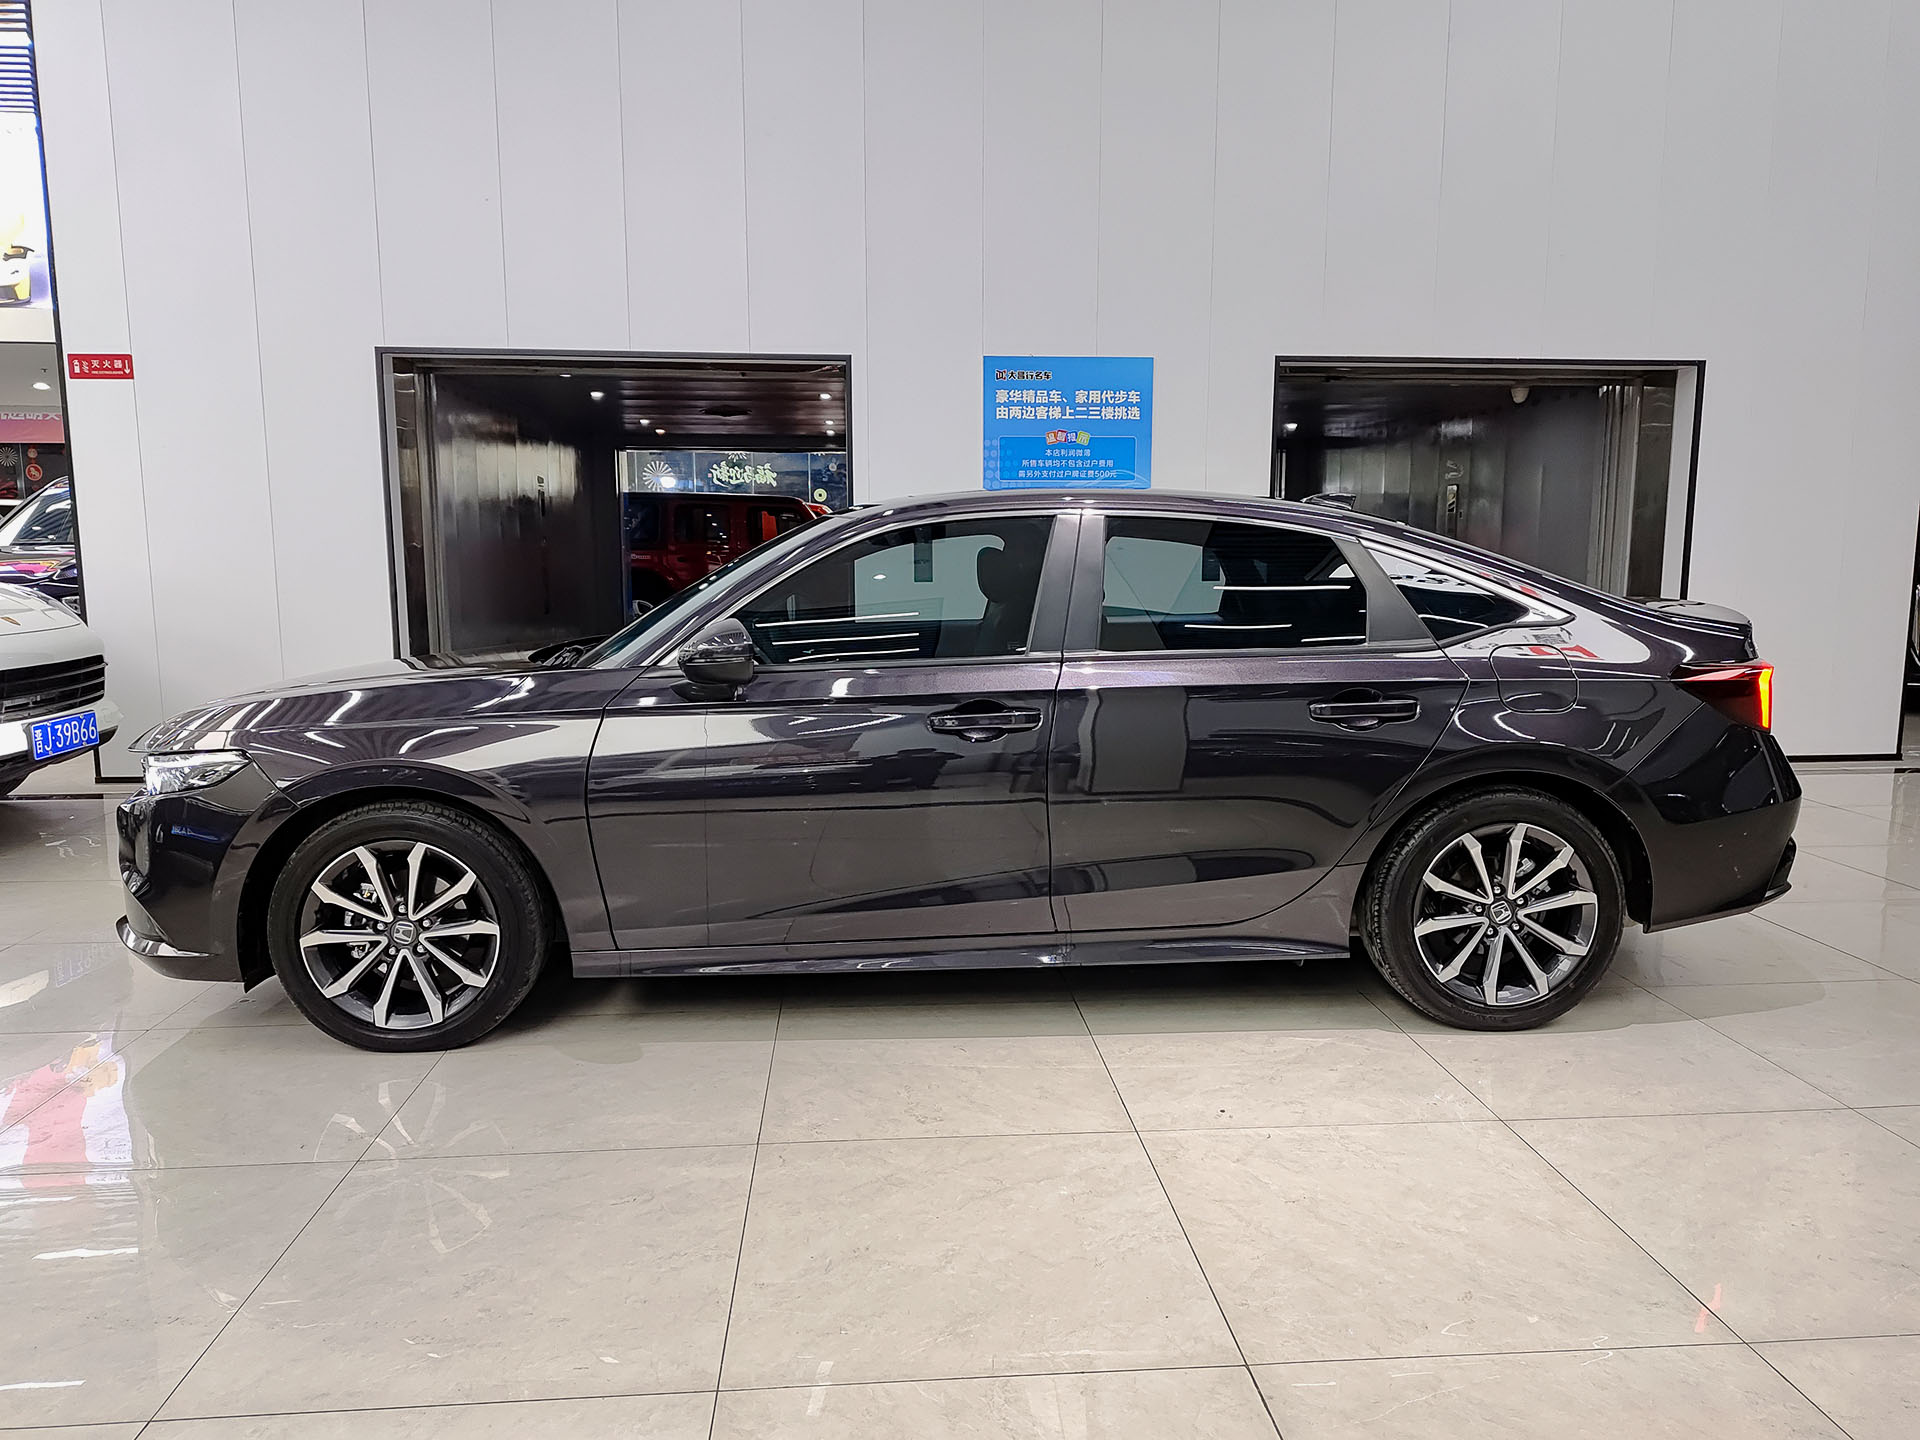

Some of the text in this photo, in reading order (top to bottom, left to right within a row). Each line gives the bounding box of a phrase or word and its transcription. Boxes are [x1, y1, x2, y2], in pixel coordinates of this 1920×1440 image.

[91, 360, 123, 369] 灭火器
[1008, 371, 1052, 380] 大昌行名车
[995, 389, 1141, 404] 豪华精品车、家用代步车
[995, 406, 1141, 420] 由两边客梯上二三楼挑选
